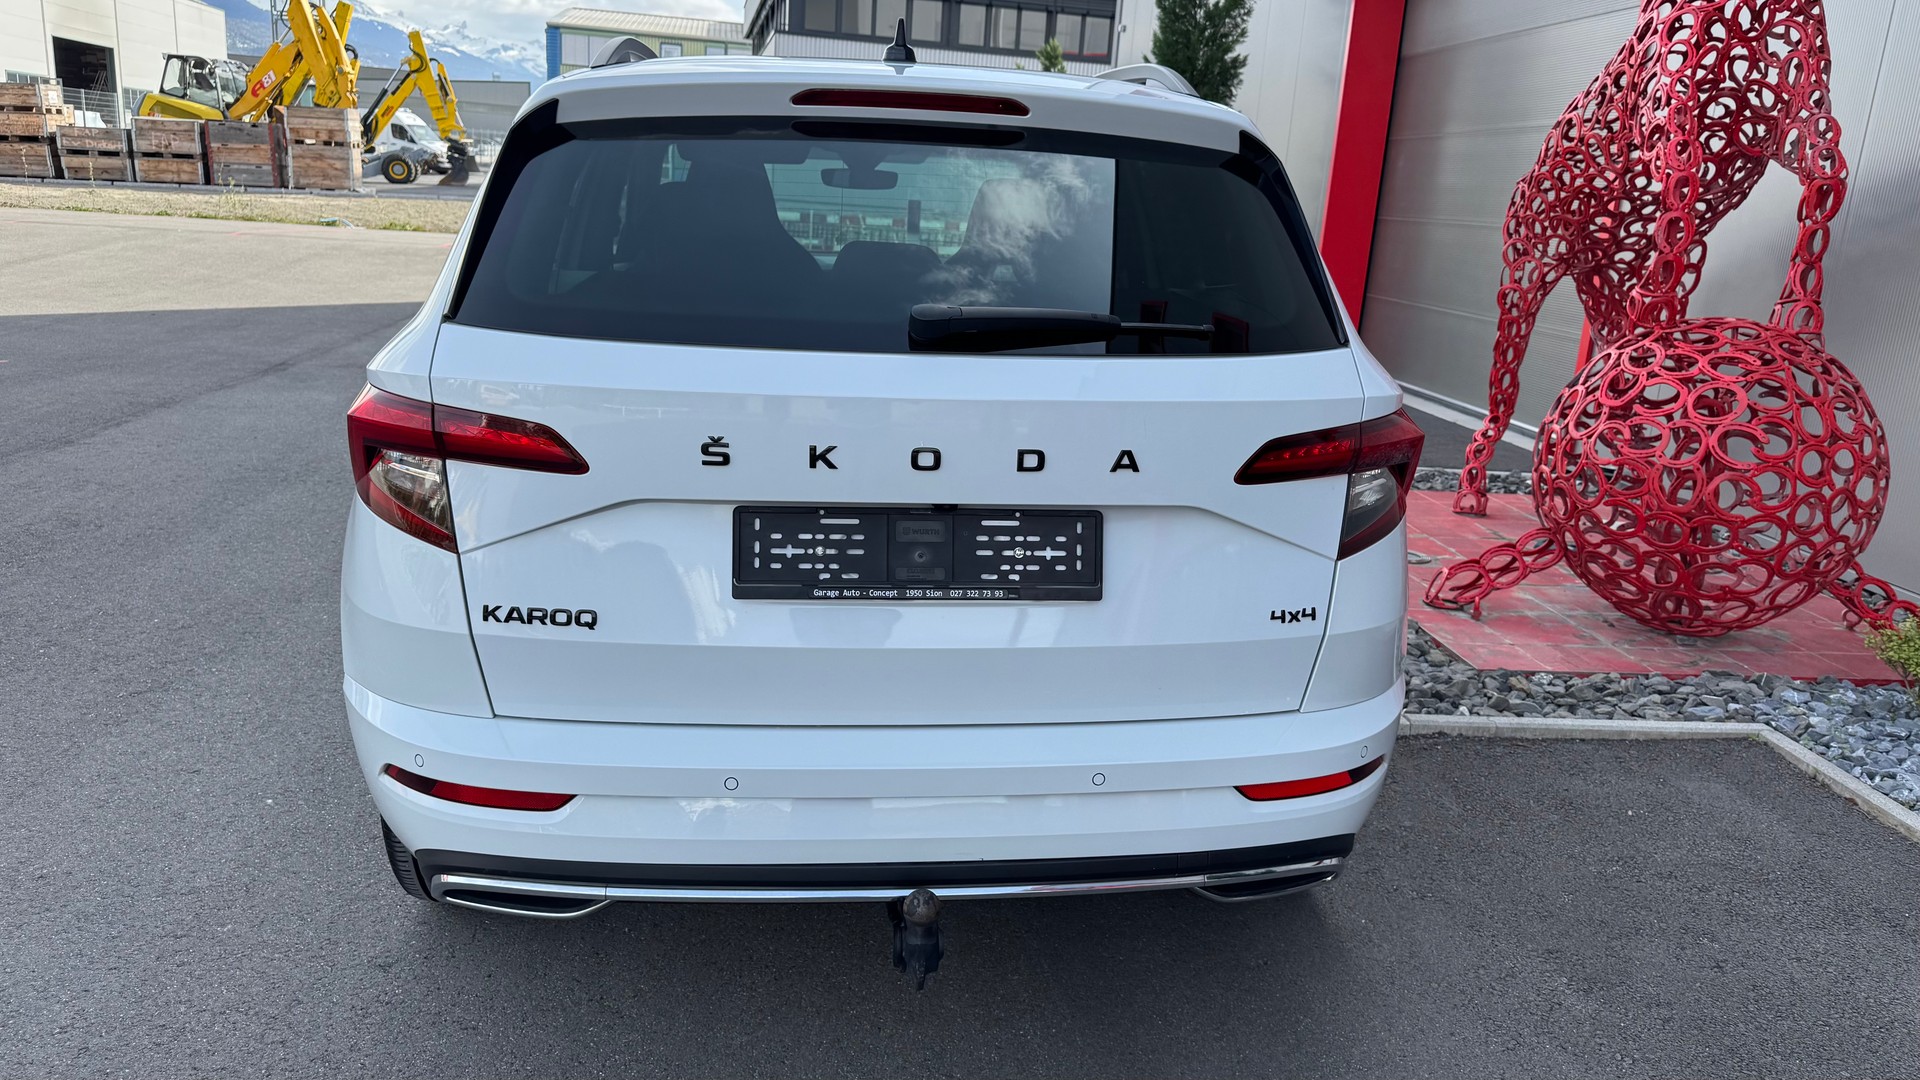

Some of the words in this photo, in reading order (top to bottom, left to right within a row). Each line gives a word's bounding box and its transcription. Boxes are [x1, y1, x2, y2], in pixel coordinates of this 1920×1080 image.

[813, 589, 840, 598] Garage
[842, 589, 861, 597] Auto
[868, 589, 898, 598] Concept
[905, 589, 923, 597] 1950
[925, 589, 943, 597] Sion
[482, 604, 598, 631] KAROQ
[1269, 606, 1317, 624] 4x4
